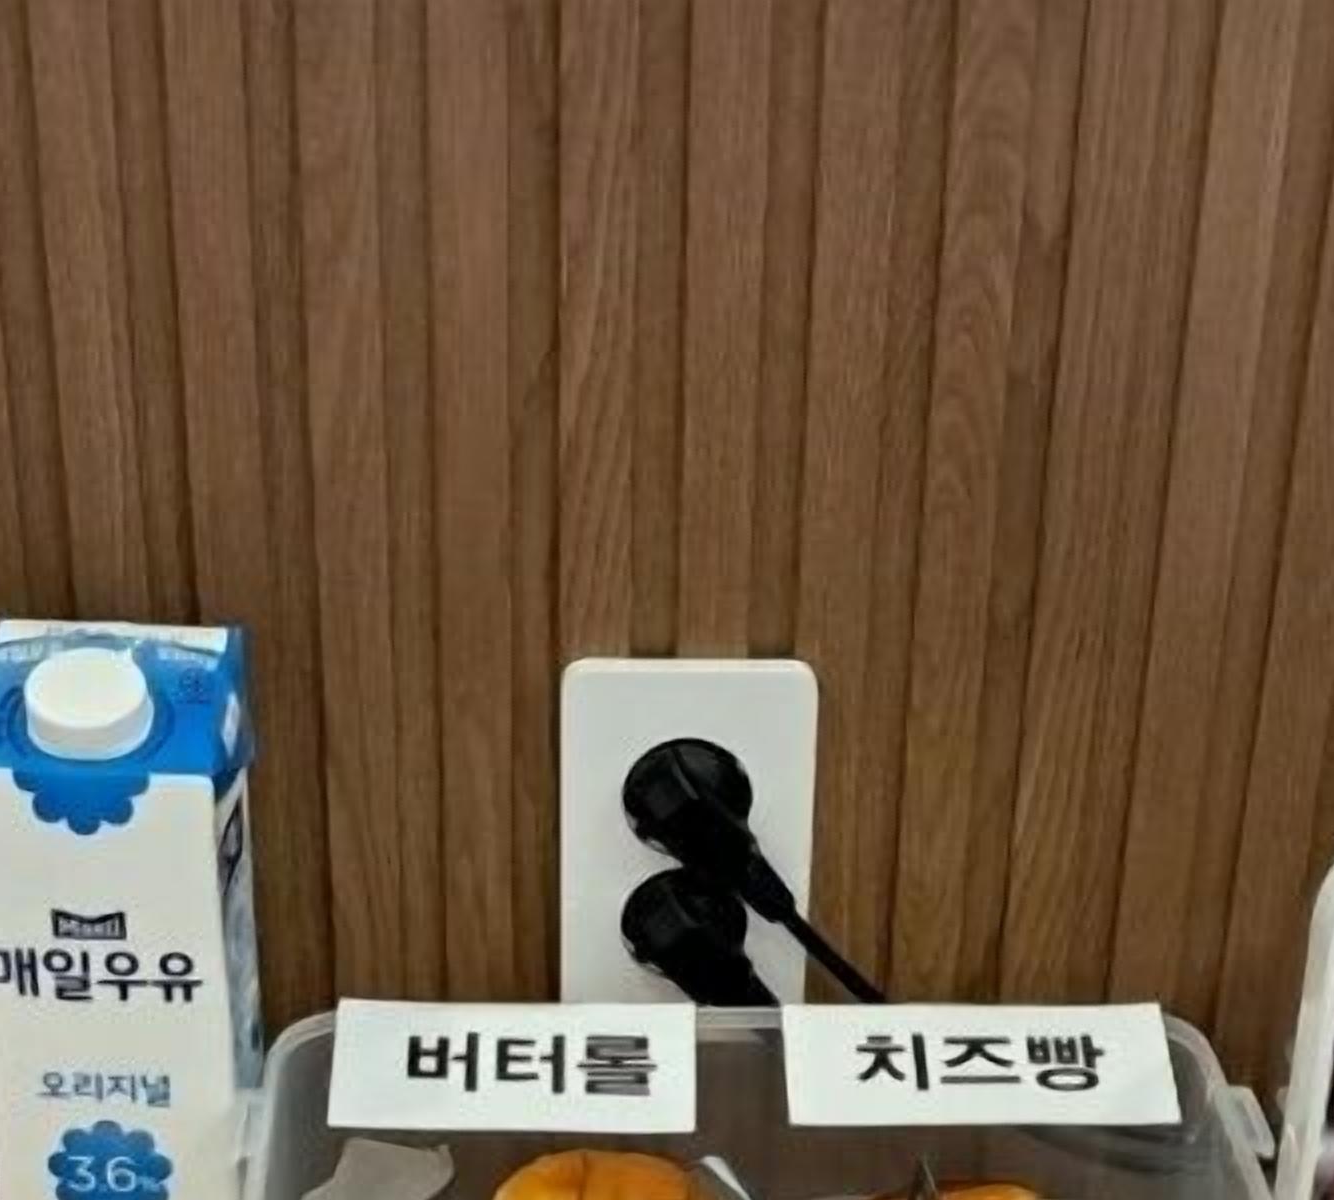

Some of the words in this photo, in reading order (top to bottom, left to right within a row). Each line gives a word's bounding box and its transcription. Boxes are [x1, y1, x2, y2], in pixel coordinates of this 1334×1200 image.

[36, 1071, 171, 1107] 오리지널
[407, 1031, 658, 1097] 버터롤
[856, 1033, 1106, 1092] 치즈빵
